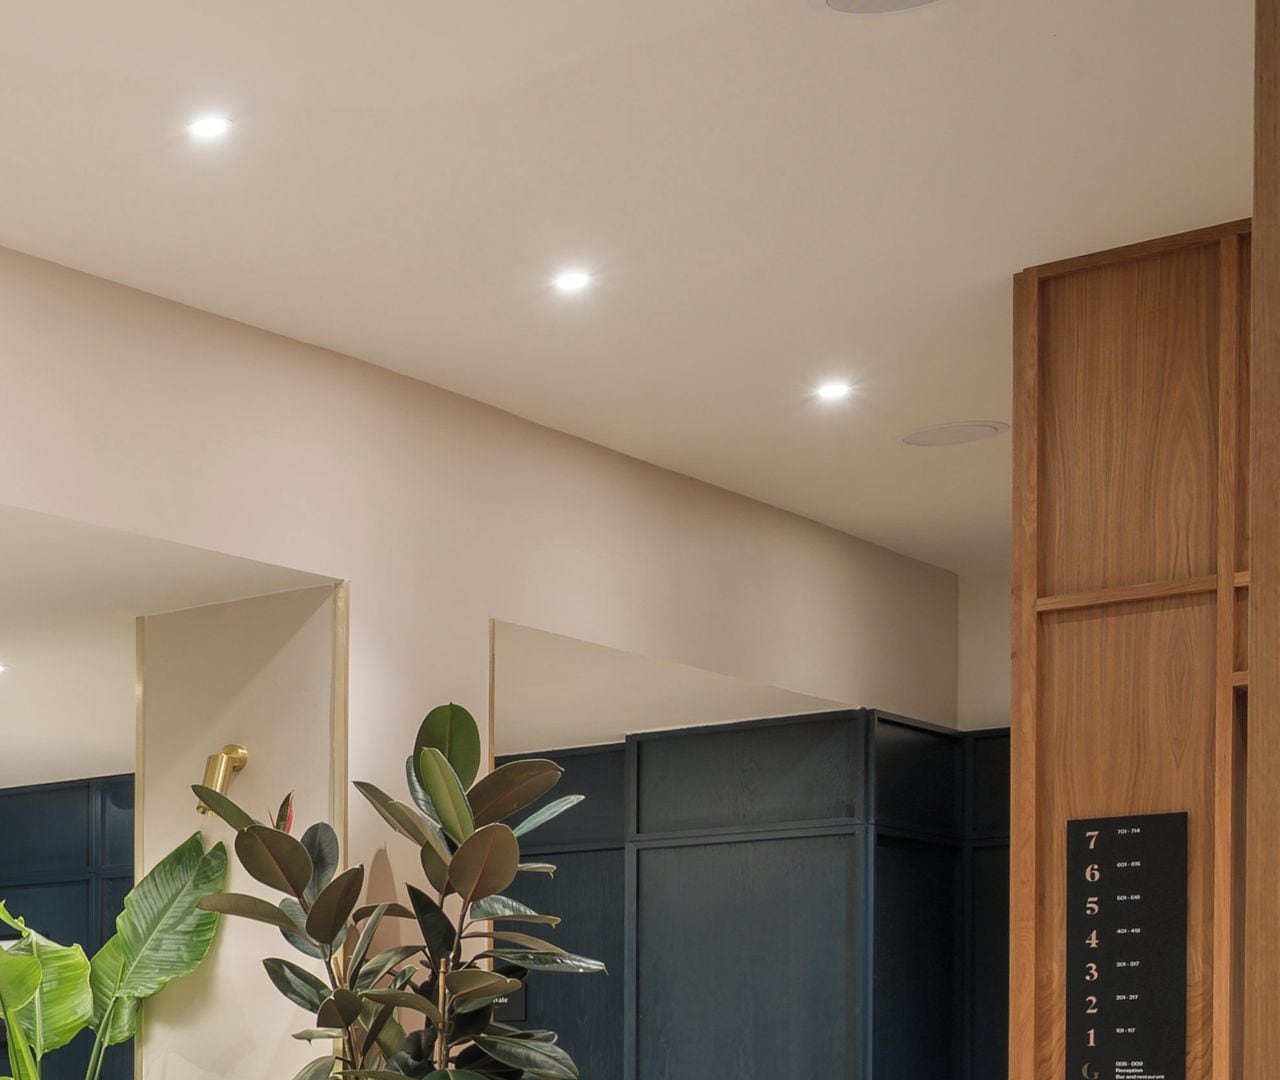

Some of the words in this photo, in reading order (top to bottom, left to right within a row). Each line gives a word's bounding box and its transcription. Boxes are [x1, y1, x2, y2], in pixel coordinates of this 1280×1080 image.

[1085, 831, 1099, 849] 7
[1085, 864, 1100, 882] 6
[1086, 897, 1099, 915] 5
[1085, 930, 1099, 948] 4
[1085, 963, 1099, 981] 3
[1085, 996, 1099, 1014] 2
[1087, 1028, 1097, 1047] 1
[1081, 1062, 1100, 1080] G
